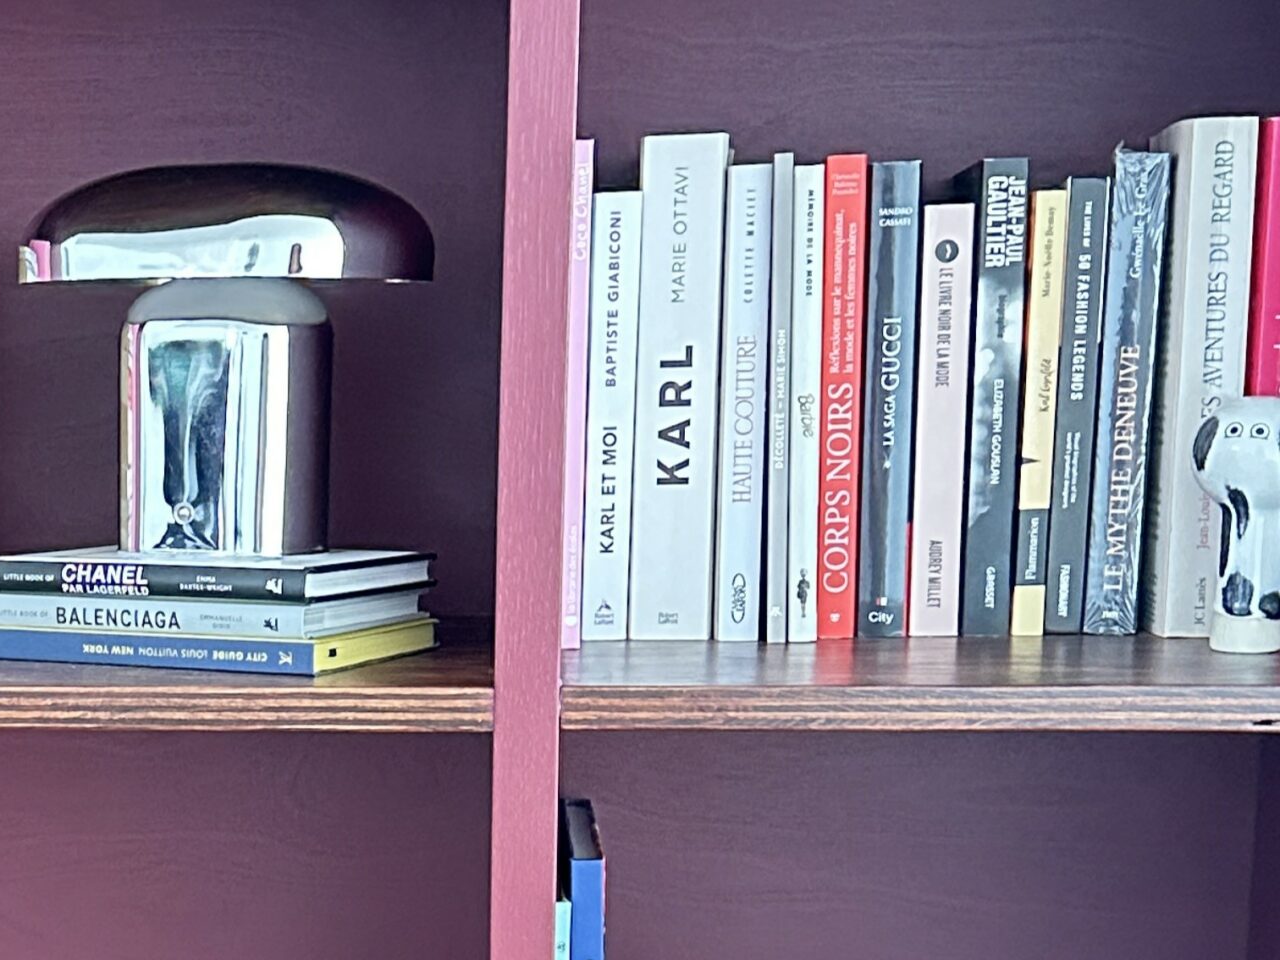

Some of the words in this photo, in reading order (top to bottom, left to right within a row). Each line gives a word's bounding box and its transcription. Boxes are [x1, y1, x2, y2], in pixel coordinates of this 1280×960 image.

[574, 162, 590, 218] Chanel
[1211, 139, 1235, 225] REGARD
[673, 165, 690, 237] OTTAVI
[985, 175, 1009, 268] GAULTIER
[1005, 175, 1027, 267] JEAN-PAUL
[573, 223, 587, 261] Coco
[806, 237, 814, 249] DE
[846, 222, 858, 255] noires
[1208, 232, 1230, 267] DU
[607, 210, 622, 303] GIABICONI
[671, 242, 686, 303] MARIE
[805, 253, 814, 265] LA
[938, 267, 954, 279] LE
[1078, 253, 1092, 270] 50
[743, 248, 756, 303] COLETTE
[805, 270, 813, 297] MODE
[830, 285, 842, 297] le
[845, 257, 857, 300] femmes
[831, 299, 842, 316] sur
[844, 301, 856, 316] les
[938, 281, 953, 307] LIVRE
[1073, 274, 1090, 335] FASHION
[845, 318, 855, 329] et
[937, 309, 952, 332] NOIR
[1203, 270, 1229, 390] AVENTURES
[605, 308, 619, 388] BAPTISTE
[777, 329, 787, 364] SIMON
[829, 317, 842, 374] Réflexions
[844, 330, 855, 362] mode
[880, 316, 902, 391] GUCCI
[935, 348, 951, 359] LA
[936, 334, 951, 346] DE
[776, 366, 787, 399] MARIE
[844, 363, 854, 373] la
[935, 361, 950, 388] MODE
[1070, 340, 1087, 402] LEGENDS
[734, 335, 757, 436] COUTURE
[1114, 344, 1141, 459] DENEUVE
[656, 344, 694, 485] KARL
[797, 393, 816, 439] Barbie
[884, 394, 896, 428] SAGA
[992, 378, 1005, 433] ELIZABETH
[602, 425, 618, 467] MOI
[826, 383, 854, 481] NOIRS
[882, 429, 894, 447] LA
[732, 440, 753, 503] HAUTE
[990, 435, 1002, 485] GOUSLAN
[601, 472, 616, 496] ET
[599, 502, 616, 553] KARL
[1107, 467, 1132, 558] MYTHE
[822, 490, 850, 594] CORPS
[928, 540, 943, 574] AUDREY
[1024, 516, 1040, 581] Flammarion
[3, 572, 24, 582] LITTLE
[24, 573, 42, 582] BOOK
[43, 574, 56, 582] OF
[61, 563, 148, 586] CHANEL
[61, 583, 84, 594] PAR
[85, 585, 150, 597] LAGERFELD
[984, 566, 996, 609] GRASSET
[1103, 564, 1124, 592] LE
[926, 576, 942, 609] MILLET
[56, 606, 181, 630] BALENCIAGA
[868, 612, 894, 626] City
[1194, 611, 1207, 627] JC
[82, 643, 109, 653] YORK
[110, 645, 134, 655] NEW
[137, 647, 179, 658] VUITTON
[180, 648, 208, 659] LOUIS
[212, 650, 244, 661] GUIDE
[245, 652, 268, 663] CITY
